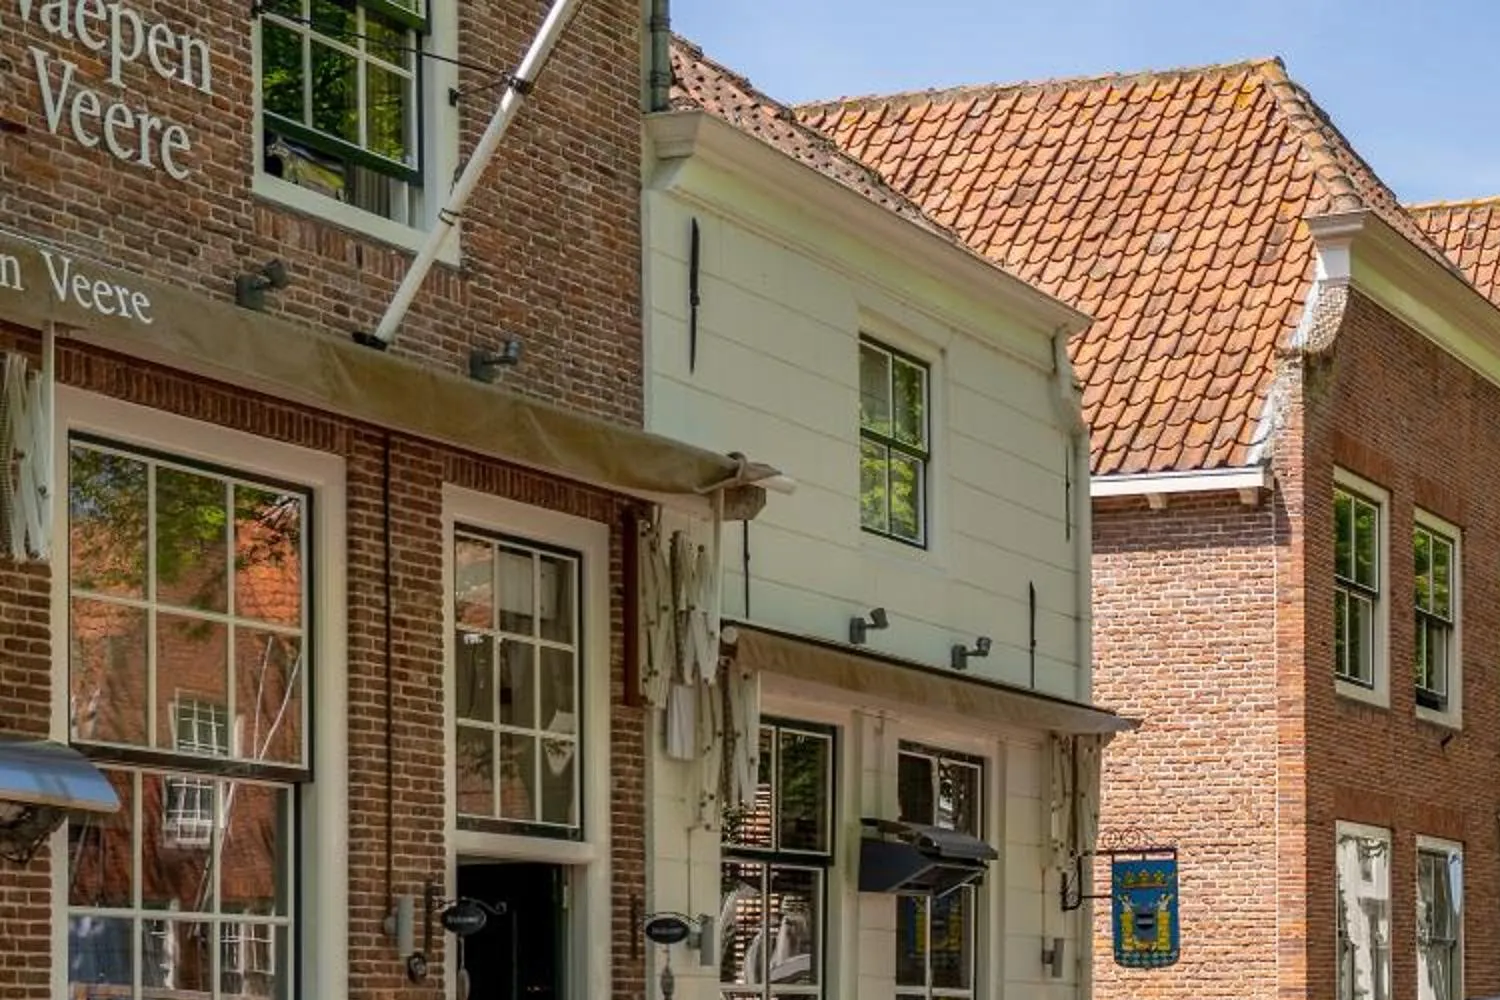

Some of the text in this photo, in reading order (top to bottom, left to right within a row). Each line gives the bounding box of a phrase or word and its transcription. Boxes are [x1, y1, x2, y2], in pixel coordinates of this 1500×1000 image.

[19, 0, 214, 95] aepen
[28, 46, 191, 180] Veere
[40, 249, 153, 324] Veere
